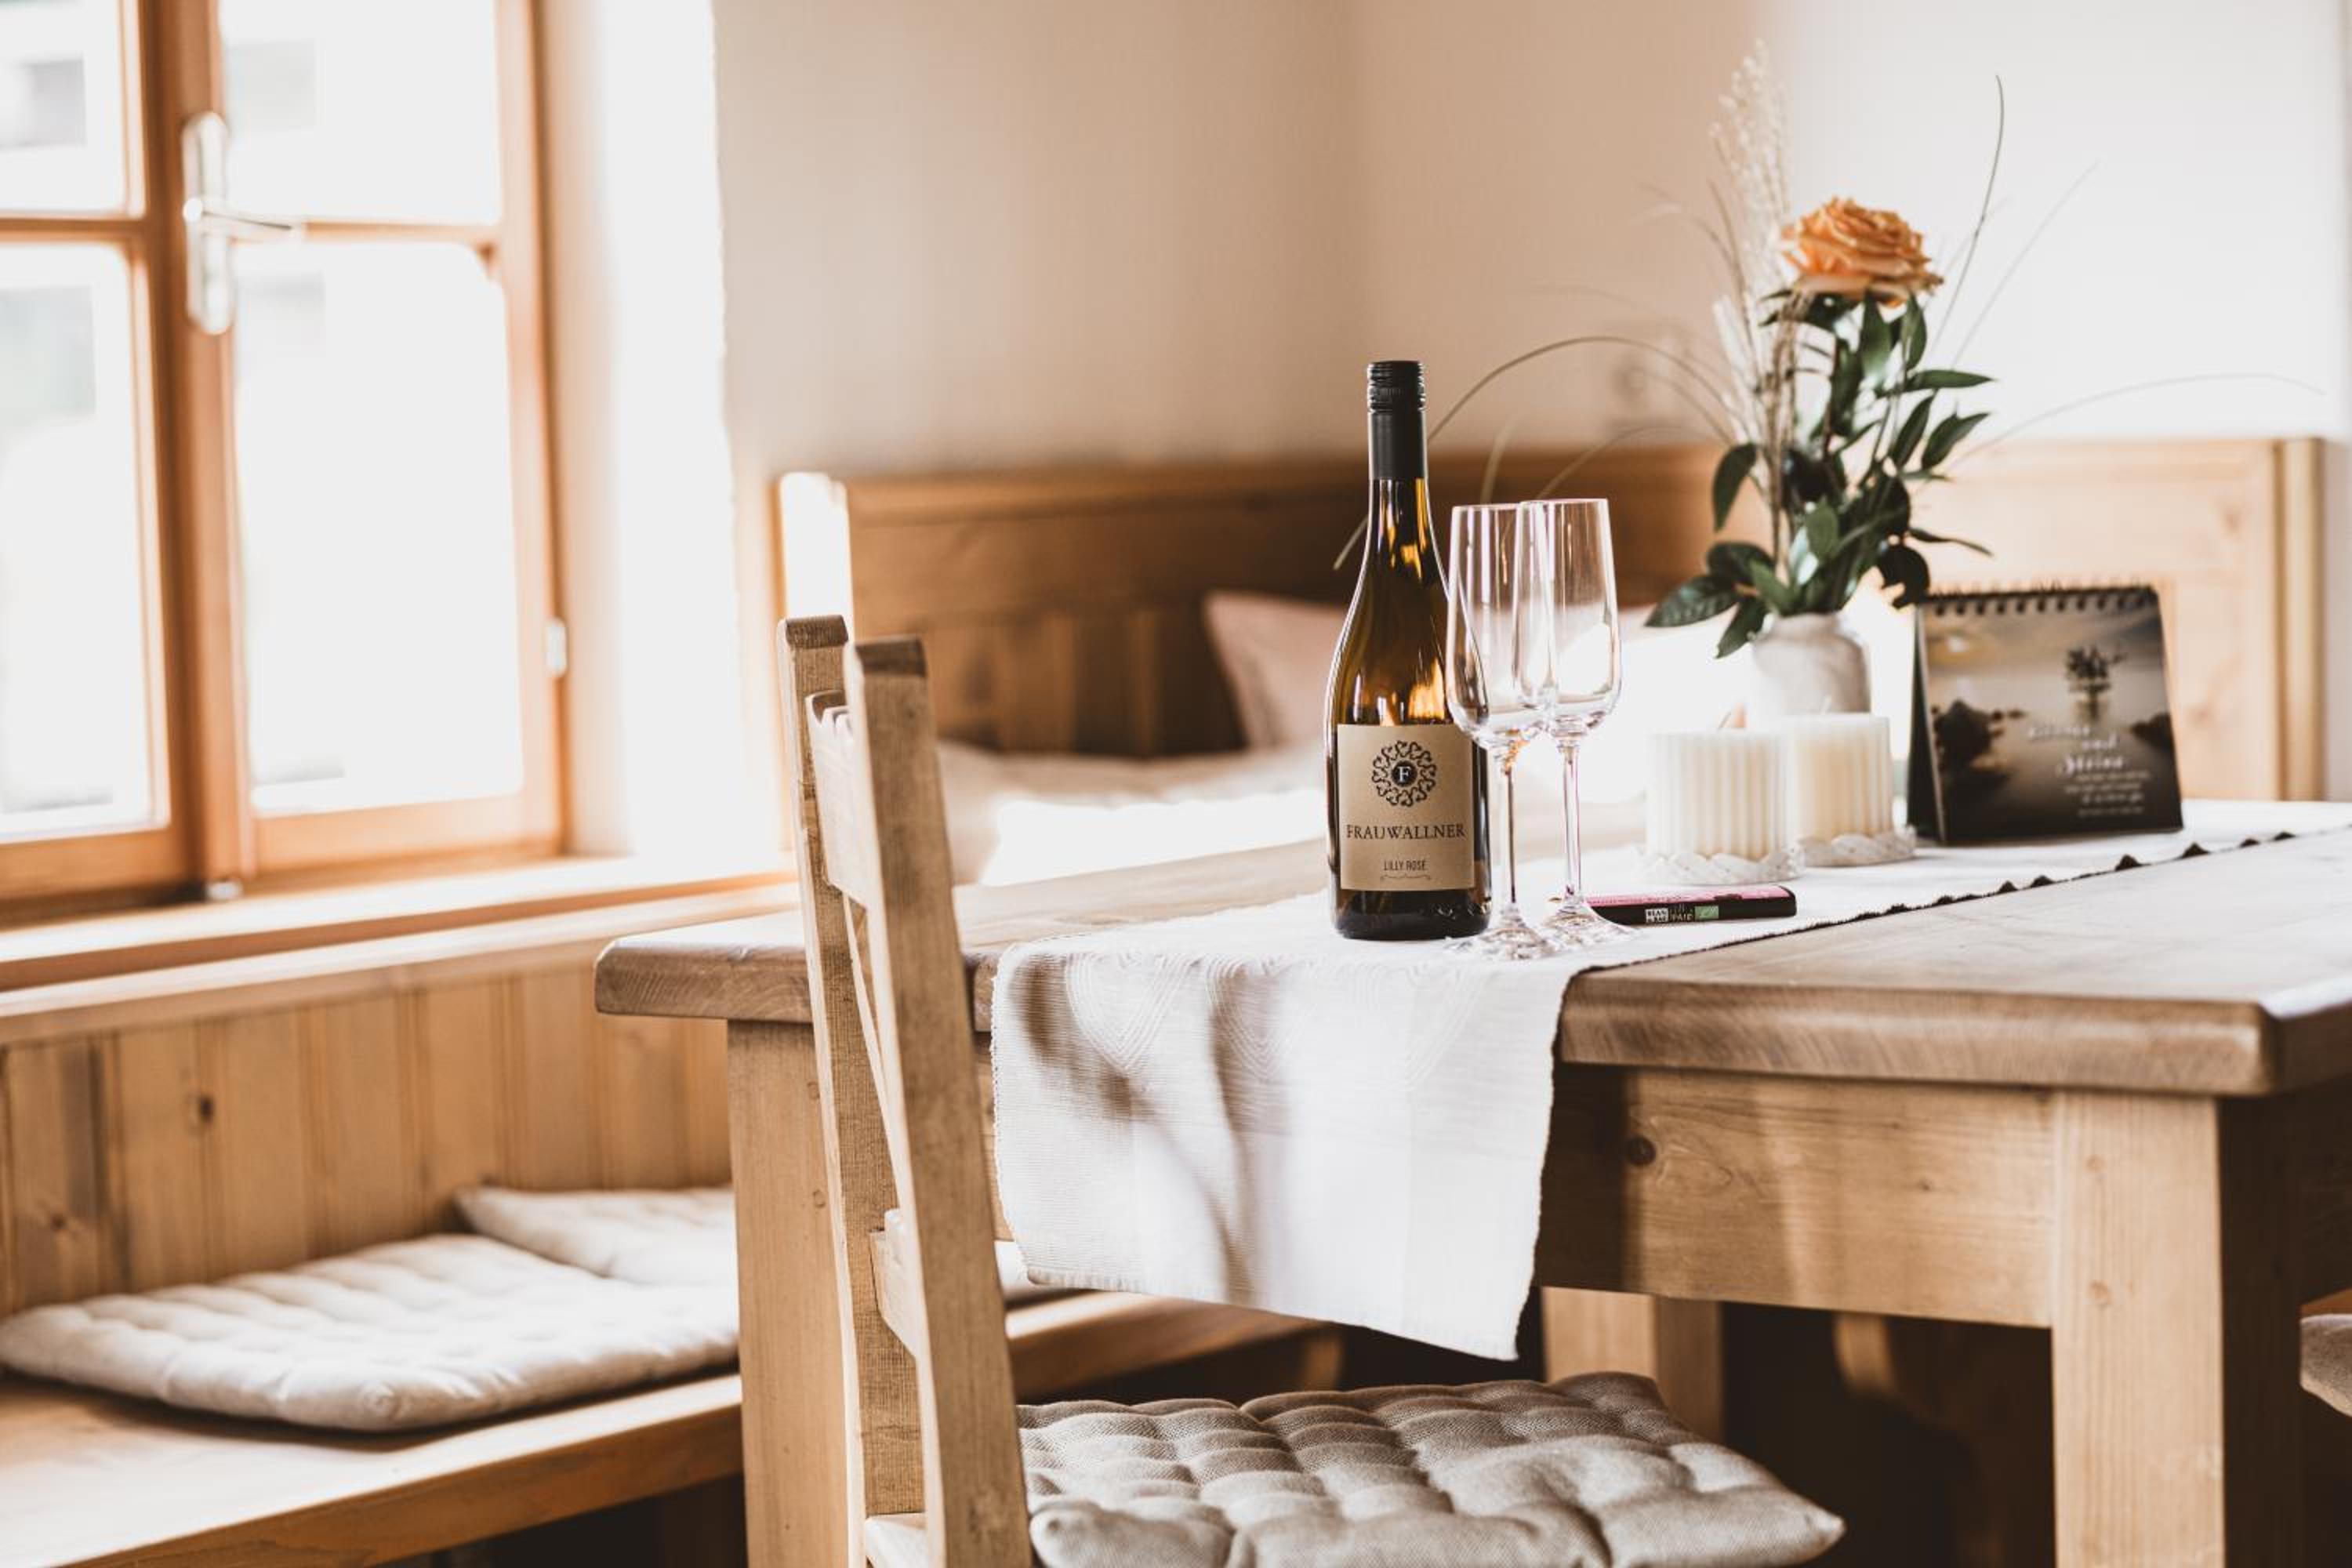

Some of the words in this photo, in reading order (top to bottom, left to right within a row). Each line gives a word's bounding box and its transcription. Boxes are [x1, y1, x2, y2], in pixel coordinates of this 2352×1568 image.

[1399, 766, 1411, 782] F
[1346, 824, 1466, 840] FRAUWALLNER
[1384, 860, 1403, 870] LILLY
